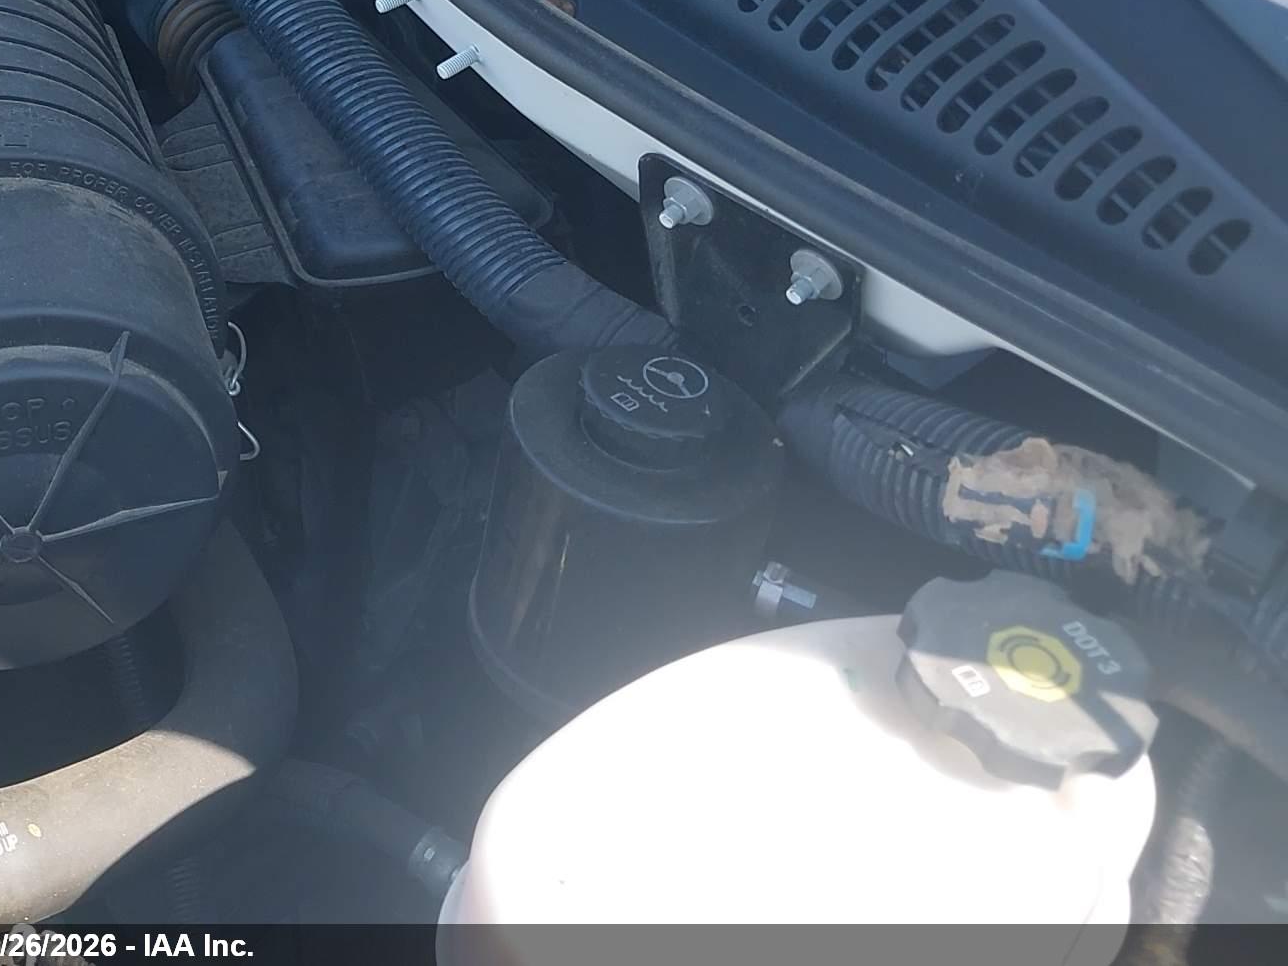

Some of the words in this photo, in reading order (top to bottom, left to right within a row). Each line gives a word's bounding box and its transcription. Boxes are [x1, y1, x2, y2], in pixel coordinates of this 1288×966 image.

[10, 161, 48, 180] FOR
[60, 166, 130, 202] PROPER
[135, 196, 184, 236] COVER
[1063, 620, 1111, 658] DOT
[1097, 659, 1121, 675] 3
[2, 834, 19, 853] UP
